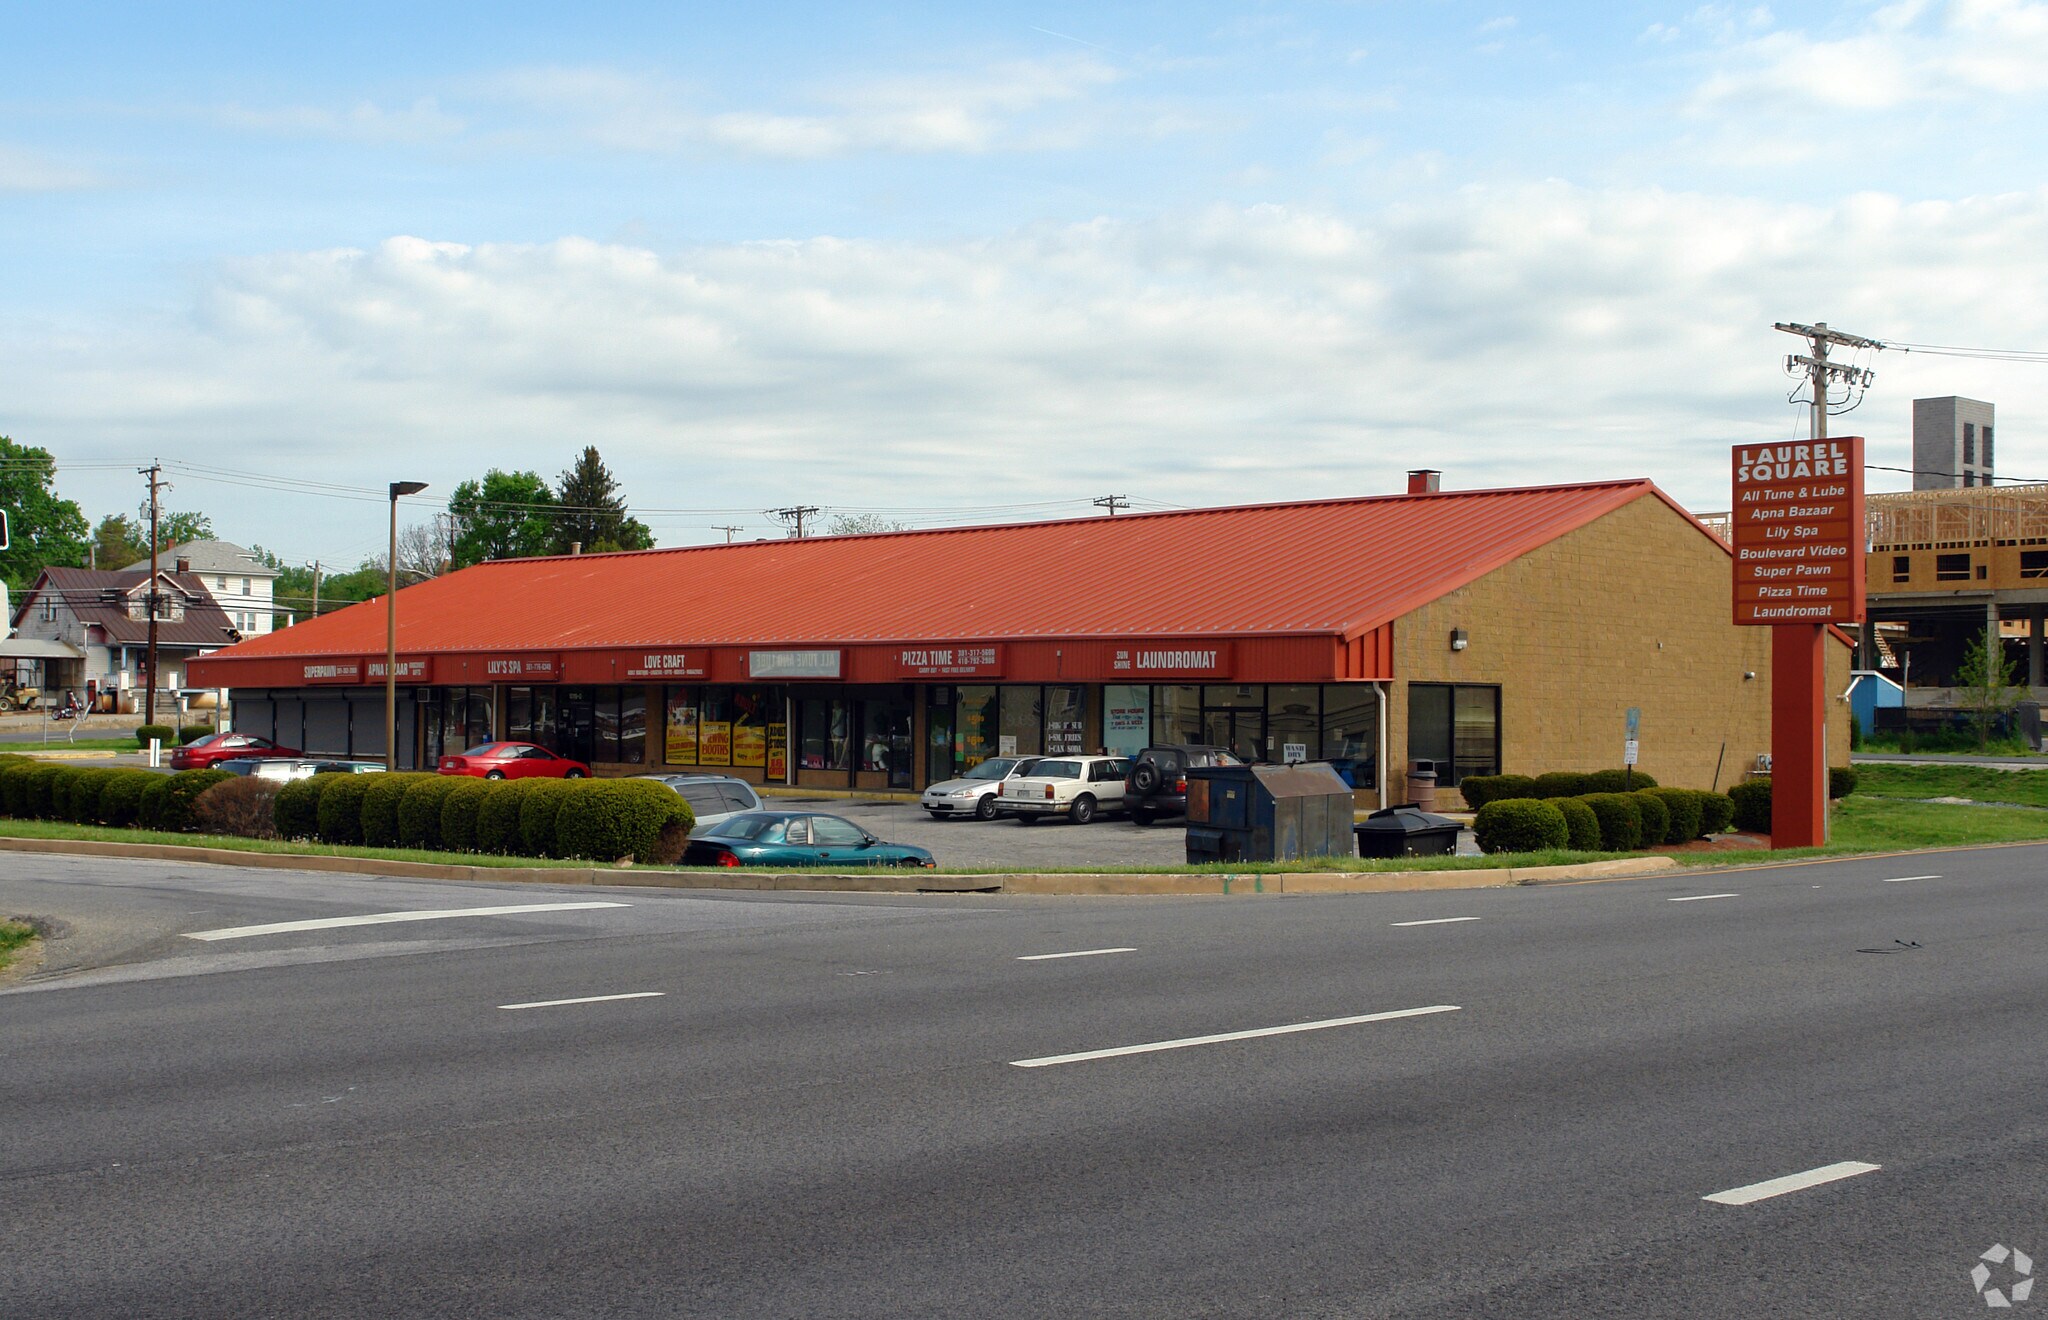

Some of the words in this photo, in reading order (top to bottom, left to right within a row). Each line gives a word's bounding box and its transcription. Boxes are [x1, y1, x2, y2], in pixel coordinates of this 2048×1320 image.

[1741, 442, 1845, 466] LAUREL
[1738, 458, 1848, 483] SQUARE
[1742, 491, 1760, 502] All
[1764, 489, 1795, 500] Tune
[1798, 487, 1808, 498] &
[1812, 486, 1846, 497] Lube
[1751, 508, 1785, 521] Apna
[1788, 505, 1835, 517] Bazaar
[1766, 527, 1790, 540] Lily
[1793, 525, 1819, 538] Spa
[1740, 547, 1806, 559] Boulevard
[1809, 546, 1847, 557] Video
[1754, 566, 1793, 578] Super
[1795, 564, 1831, 575] Pawn
[1758, 586, 1792, 597] Pizza
[1796, 585, 1828, 596] Time
[1753, 605, 1832, 618] Laundromat
[644, 655, 661, 669] LOVE
[662, 654, 685, 668] CRAFT
[902, 651, 928, 666] PIZZA
[929, 650, 953, 666] TIME
[1116, 650, 1129, 660] SUN
[1136, 650, 1217, 669] LAUNDROMAT
[368, 663, 384, 676] APNA
[385, 662, 408, 676] BZAAR
[487, 661, 507, 674] LILY'S
[508, 660, 522, 674] SPA
[1064, 734, 1082, 742] FRIES
[702, 744, 729, 755] BOOTHS
[1067, 745, 1082, 753] SODA
